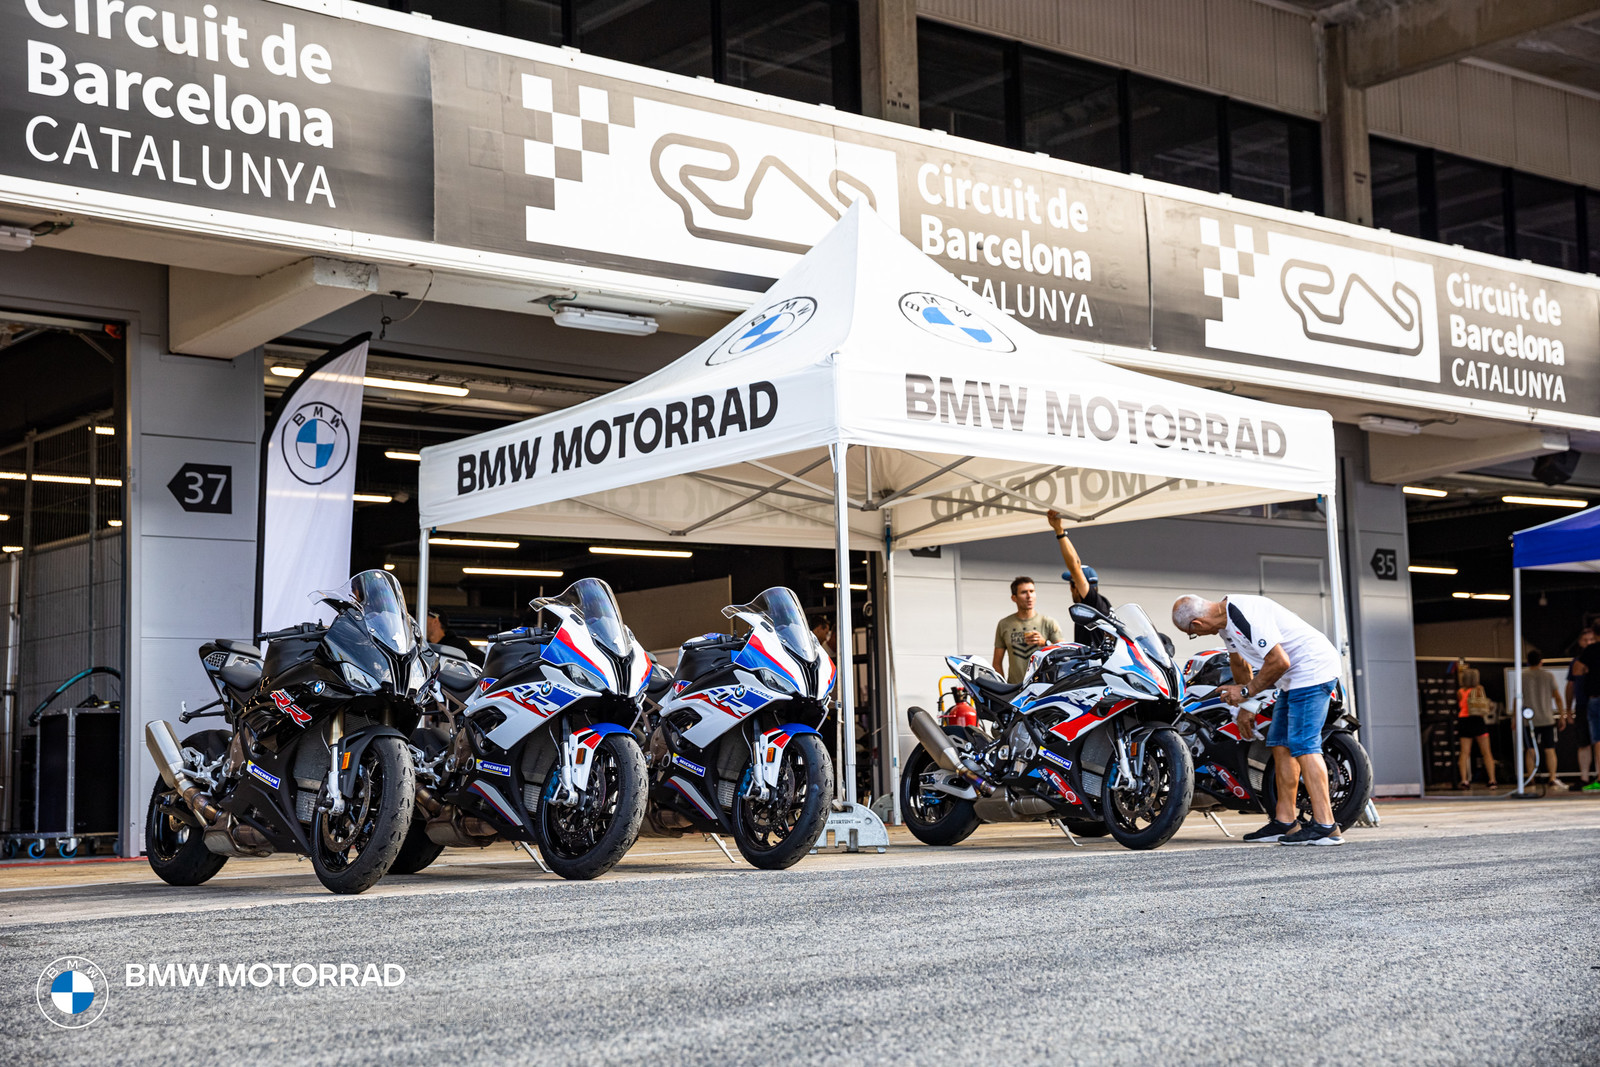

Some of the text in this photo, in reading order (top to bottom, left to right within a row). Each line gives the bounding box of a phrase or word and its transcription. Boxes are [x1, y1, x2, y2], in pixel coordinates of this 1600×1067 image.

[24, 0, 332, 84] Circuit de
[27, 39, 334, 149] Barcelona
[25, 115, 336, 208] CATALUNYA
[917, 163, 1089, 232] Circuit de
[920, 213, 1092, 282] Barcelona
[751, 301, 812, 327] BMW
[905, 295, 972, 318] BMW
[950, 272, 1094, 327] TALUNYA
[1446, 272, 1562, 326] Circuit de
[1450, 313, 1565, 366] Barcelona
[1452, 358, 1567, 403] CATALUNYA
[293, 406, 341, 428] BMW
[457, 380, 779, 496] BMW MOTORRAD
[905, 373, 1287, 461] BMW MOTORRAD
[184, 471, 228, 505] 37
[1377, 553, 1396, 576] 35
[270, 690, 312, 729] RR
[554, 683, 582, 697] S1000
[253, 767, 278, 785] MICHELIN
[483, 763, 509, 773] MICHELIN
